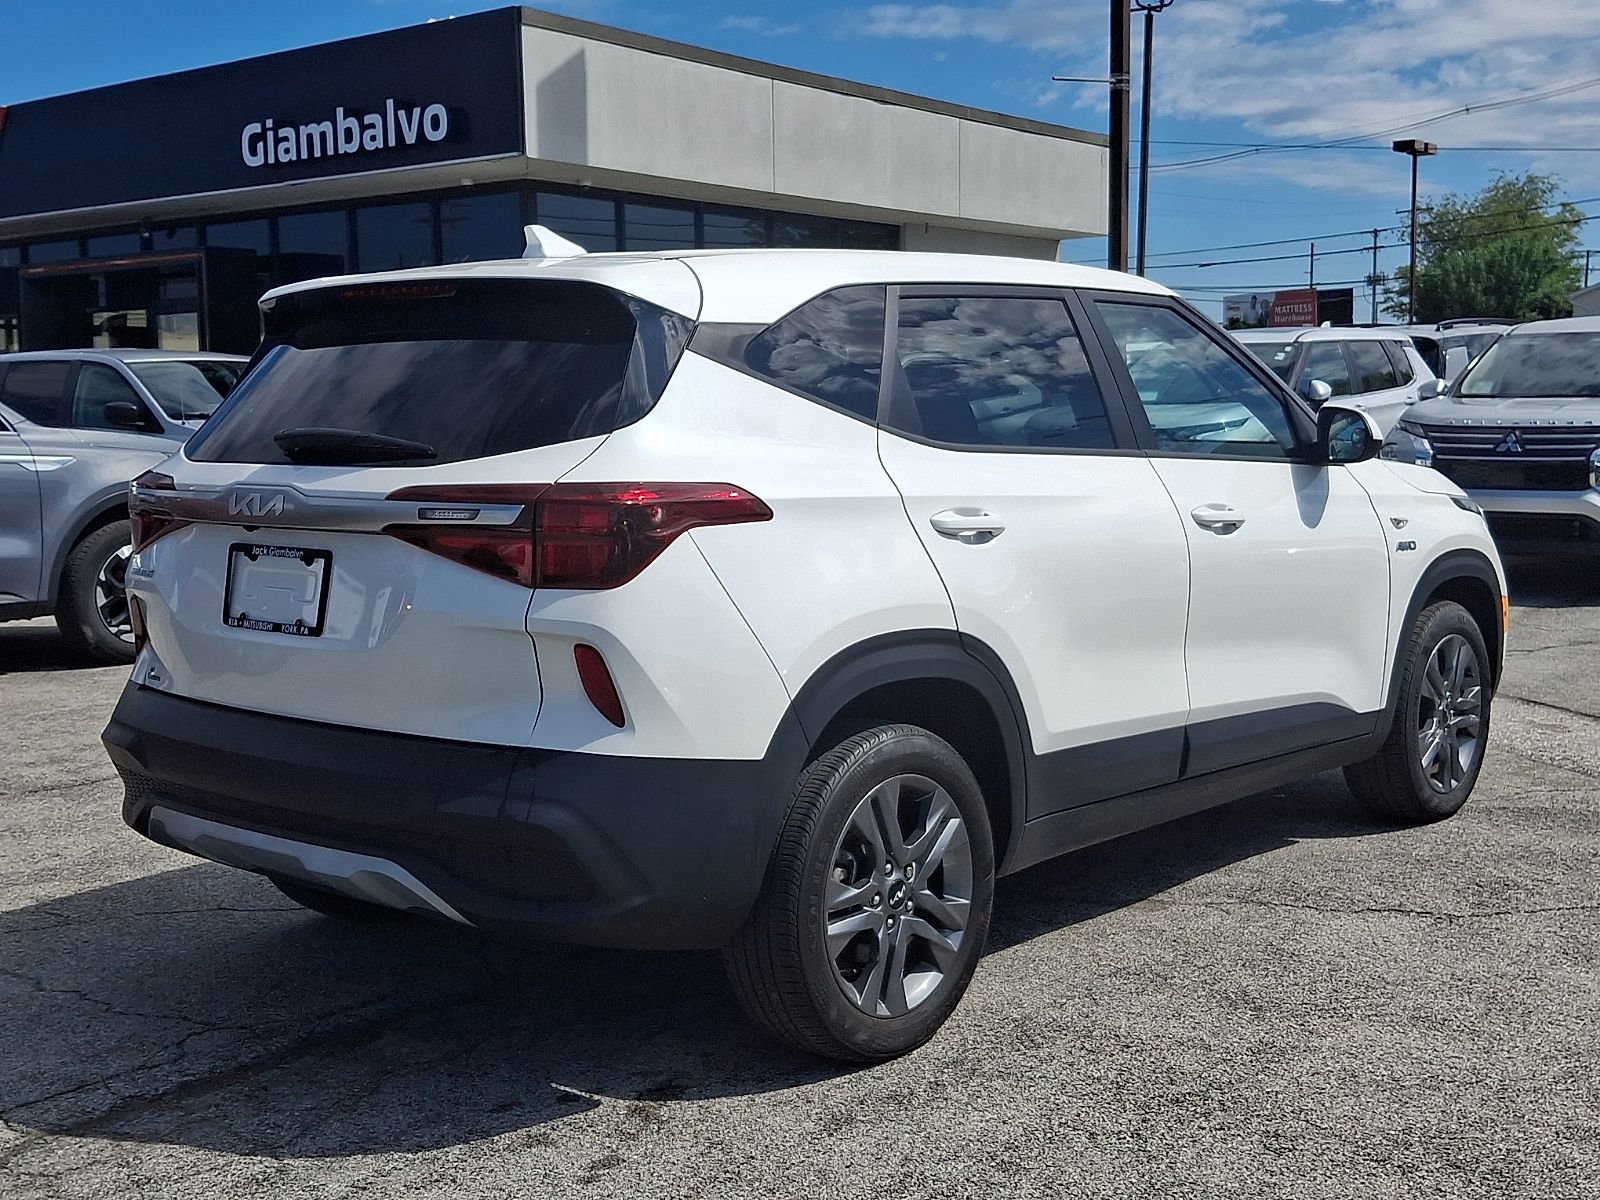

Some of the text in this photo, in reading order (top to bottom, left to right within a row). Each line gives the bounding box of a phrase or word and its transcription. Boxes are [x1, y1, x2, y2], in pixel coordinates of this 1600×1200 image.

[241, 98, 448, 167] Giambalvo
[1274, 303, 1312, 314] MATTRESS
[228, 493, 285, 516] KIA
[252, 546, 268, 555] Jack
[243, 620, 273, 631] MITSUBISHI
